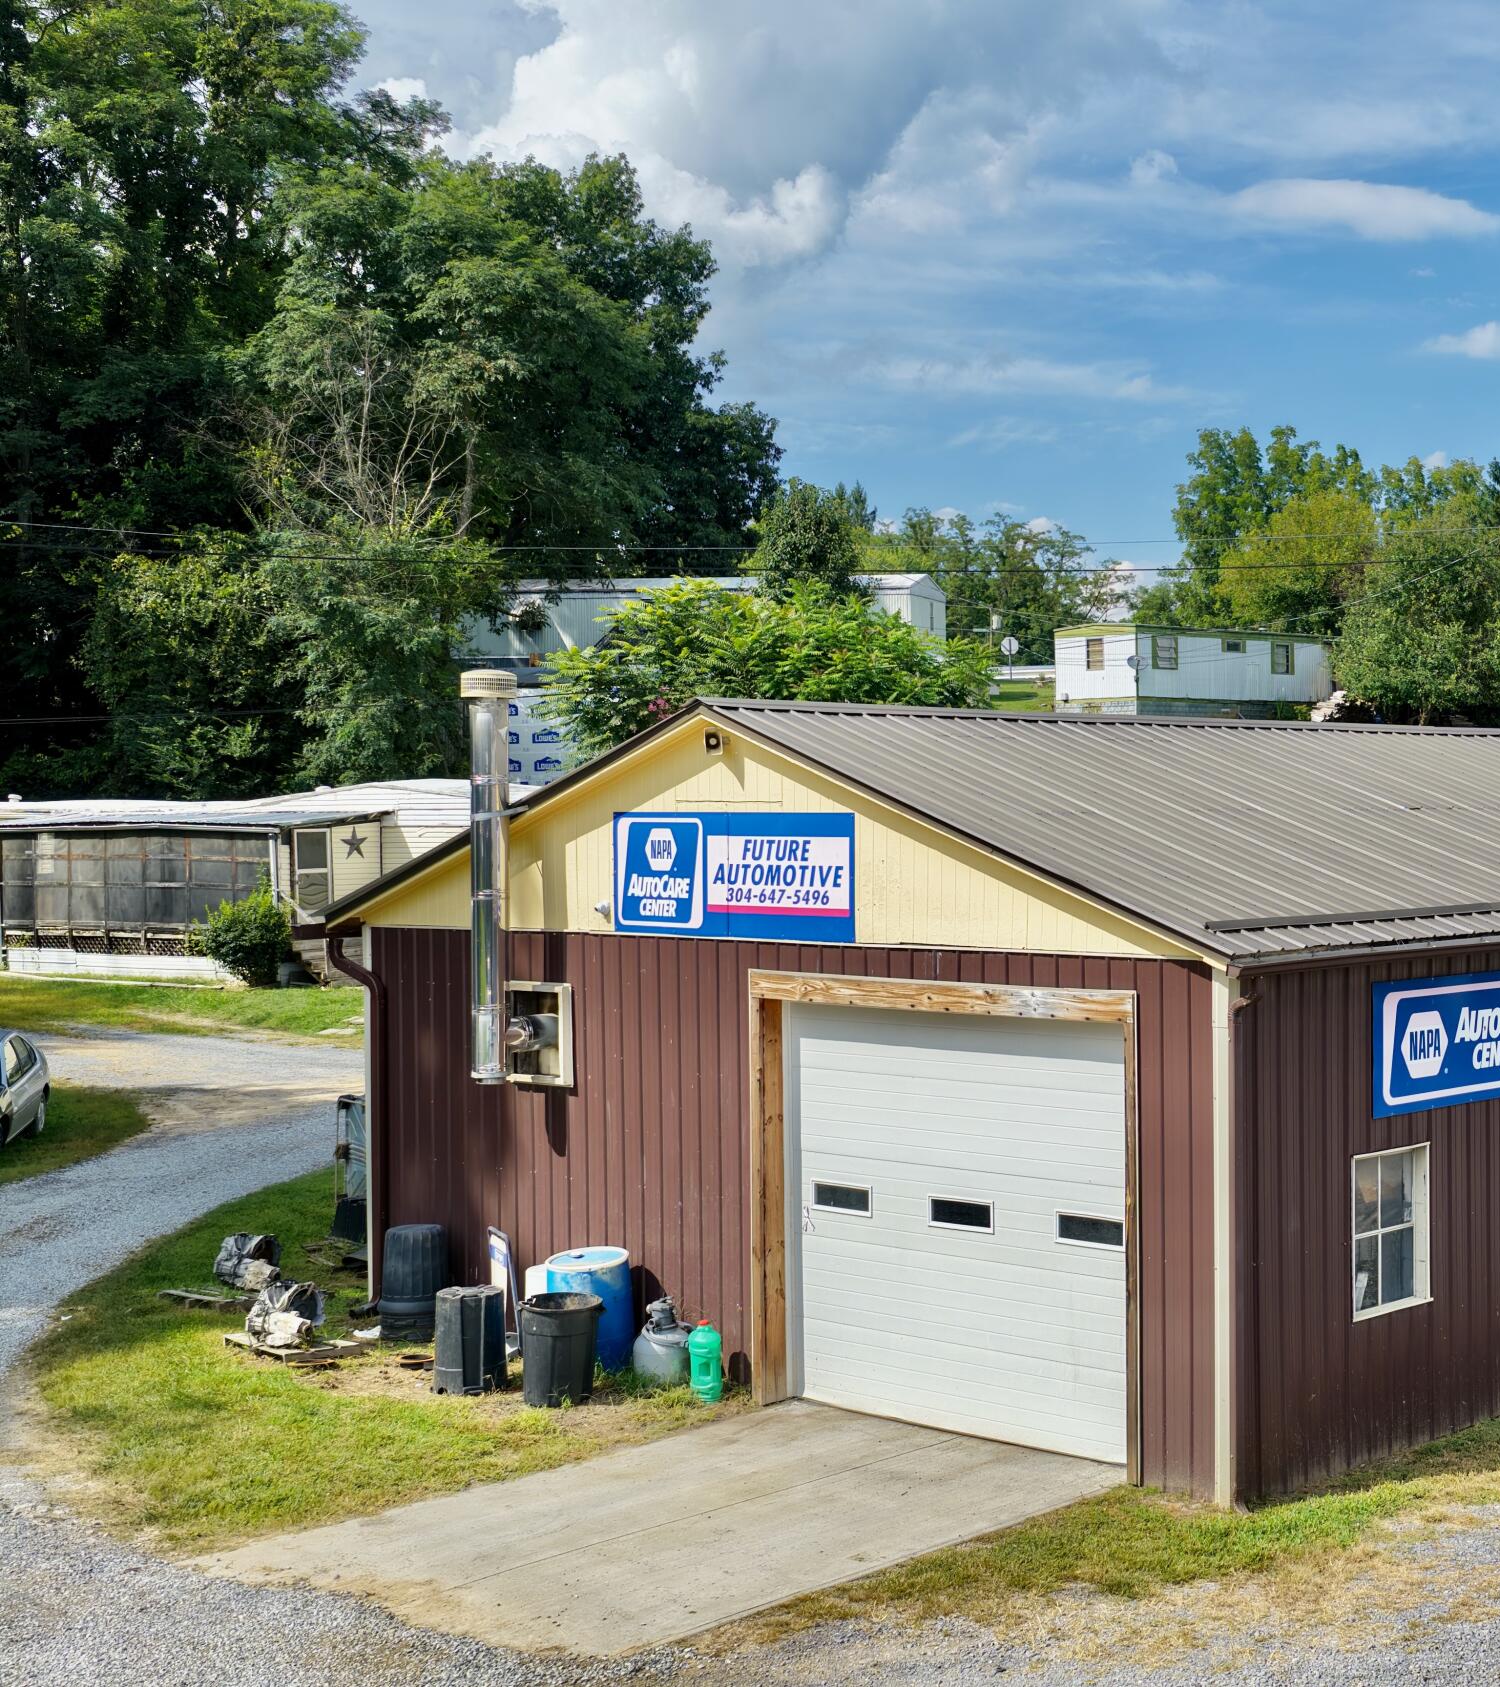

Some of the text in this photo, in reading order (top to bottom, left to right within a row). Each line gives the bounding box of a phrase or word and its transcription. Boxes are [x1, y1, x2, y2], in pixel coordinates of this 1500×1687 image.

[651, 840, 672, 859] NAPA
[742, 839, 811, 861] FUTURE
[713, 863, 844, 888] AUTOMOTIVE
[726, 887, 830, 905] 304-647-5496
[640, 898, 677, 917] CENTER
[1410, 1028, 1441, 1061] NAPA
